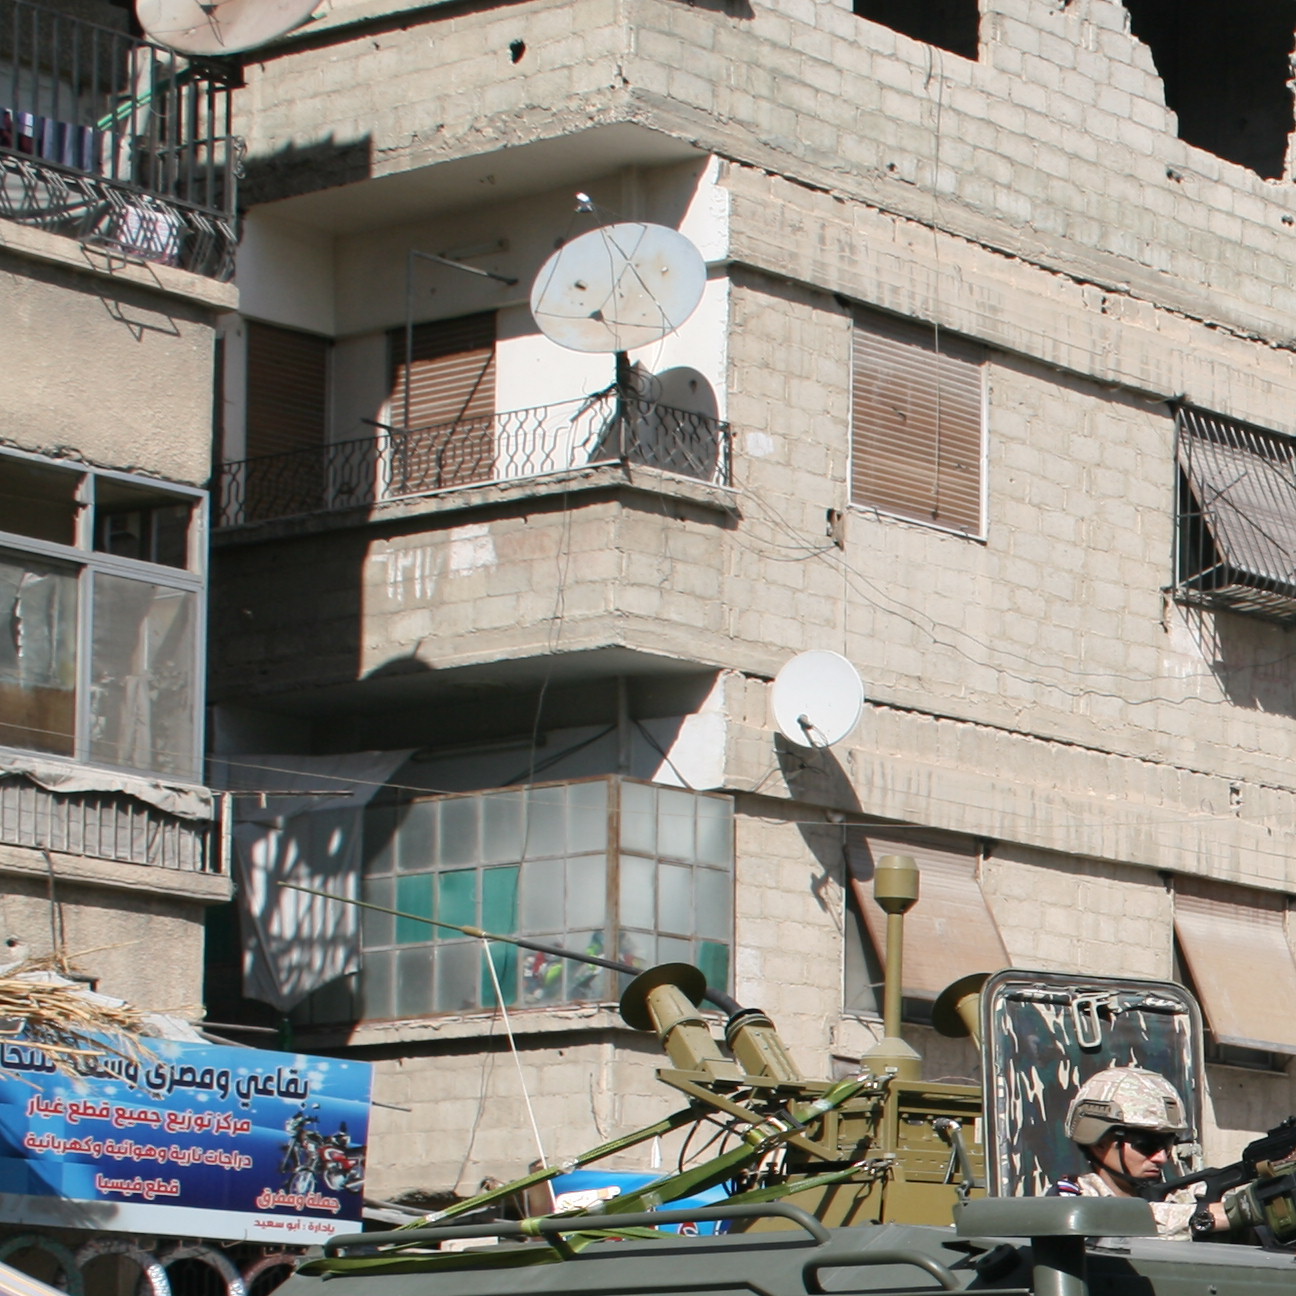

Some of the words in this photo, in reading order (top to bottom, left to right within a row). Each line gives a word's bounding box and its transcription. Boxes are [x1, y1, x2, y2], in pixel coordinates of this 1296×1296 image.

[236, 1067, 309, 1108] بقاعي
[26, 1094, 65, 1117] غيار
[67, 1100, 110, 1123] قطع
[113, 1106, 162, 1129] جميع
[166, 1110, 213, 1132] توزيع
[212, 1112, 252, 1134] مركز
[24, 1133, 103, 1159] وكهربائية
[104, 1140, 167, 1163] وهوائية
[168, 1146, 203, 1167] نارية
[204, 1149, 252, 1171] دراجات
[95, 1173, 143, 1195] فيسبا
[143, 1178, 180, 1199] قطع
[255, 1187, 305, 1211] ومفرق
[305, 1190, 341, 1213] جملة
[254, 1218, 284, 1231] سعيد
